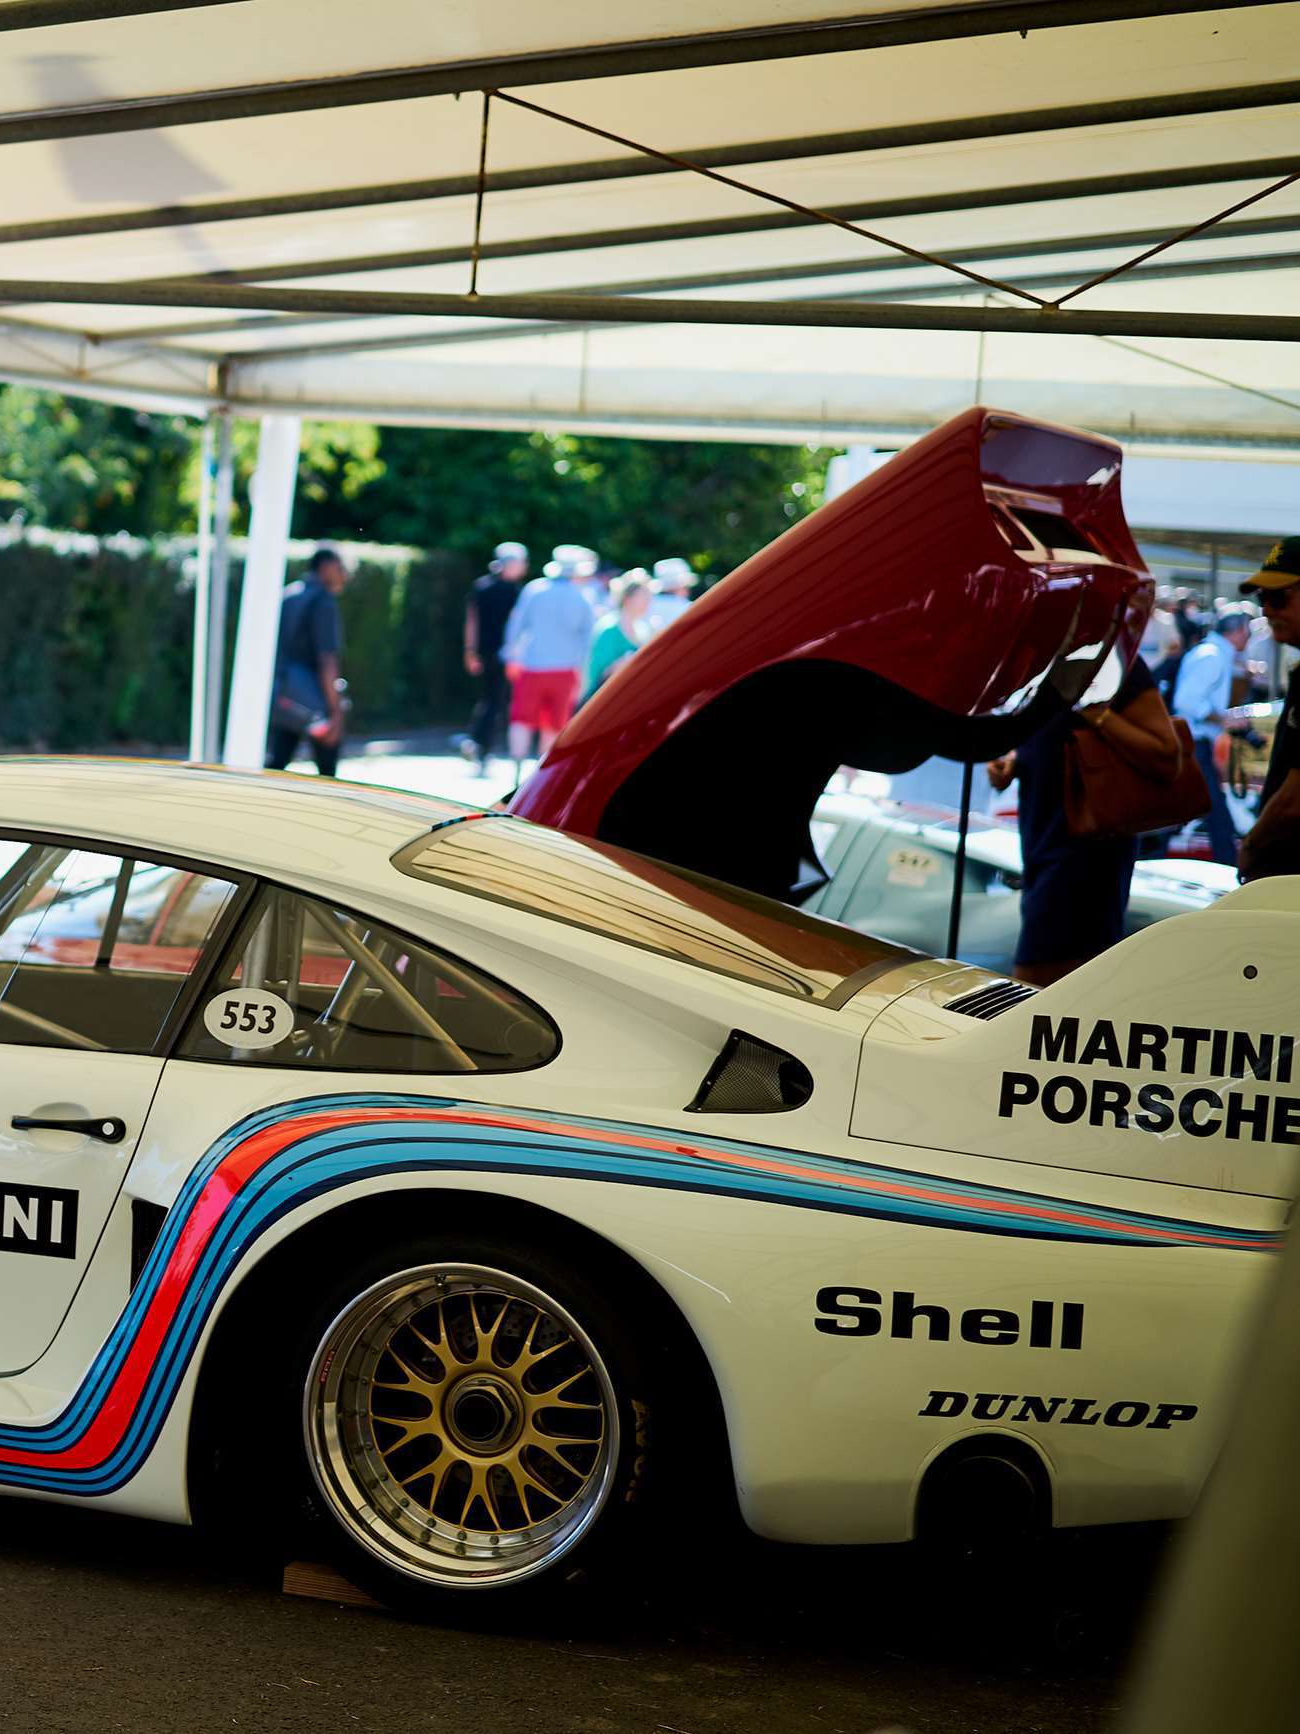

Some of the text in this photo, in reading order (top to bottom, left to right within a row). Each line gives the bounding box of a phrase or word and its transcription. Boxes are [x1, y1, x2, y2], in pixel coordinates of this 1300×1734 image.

[220, 1000, 277, 1034] 553
[1028, 1015, 1295, 1084] MARTINI
[998, 1071, 1300, 1146] PORSCHE
[814, 1286, 1085, 1350] Shell
[918, 1390, 1199, 1430] DUNLOP
